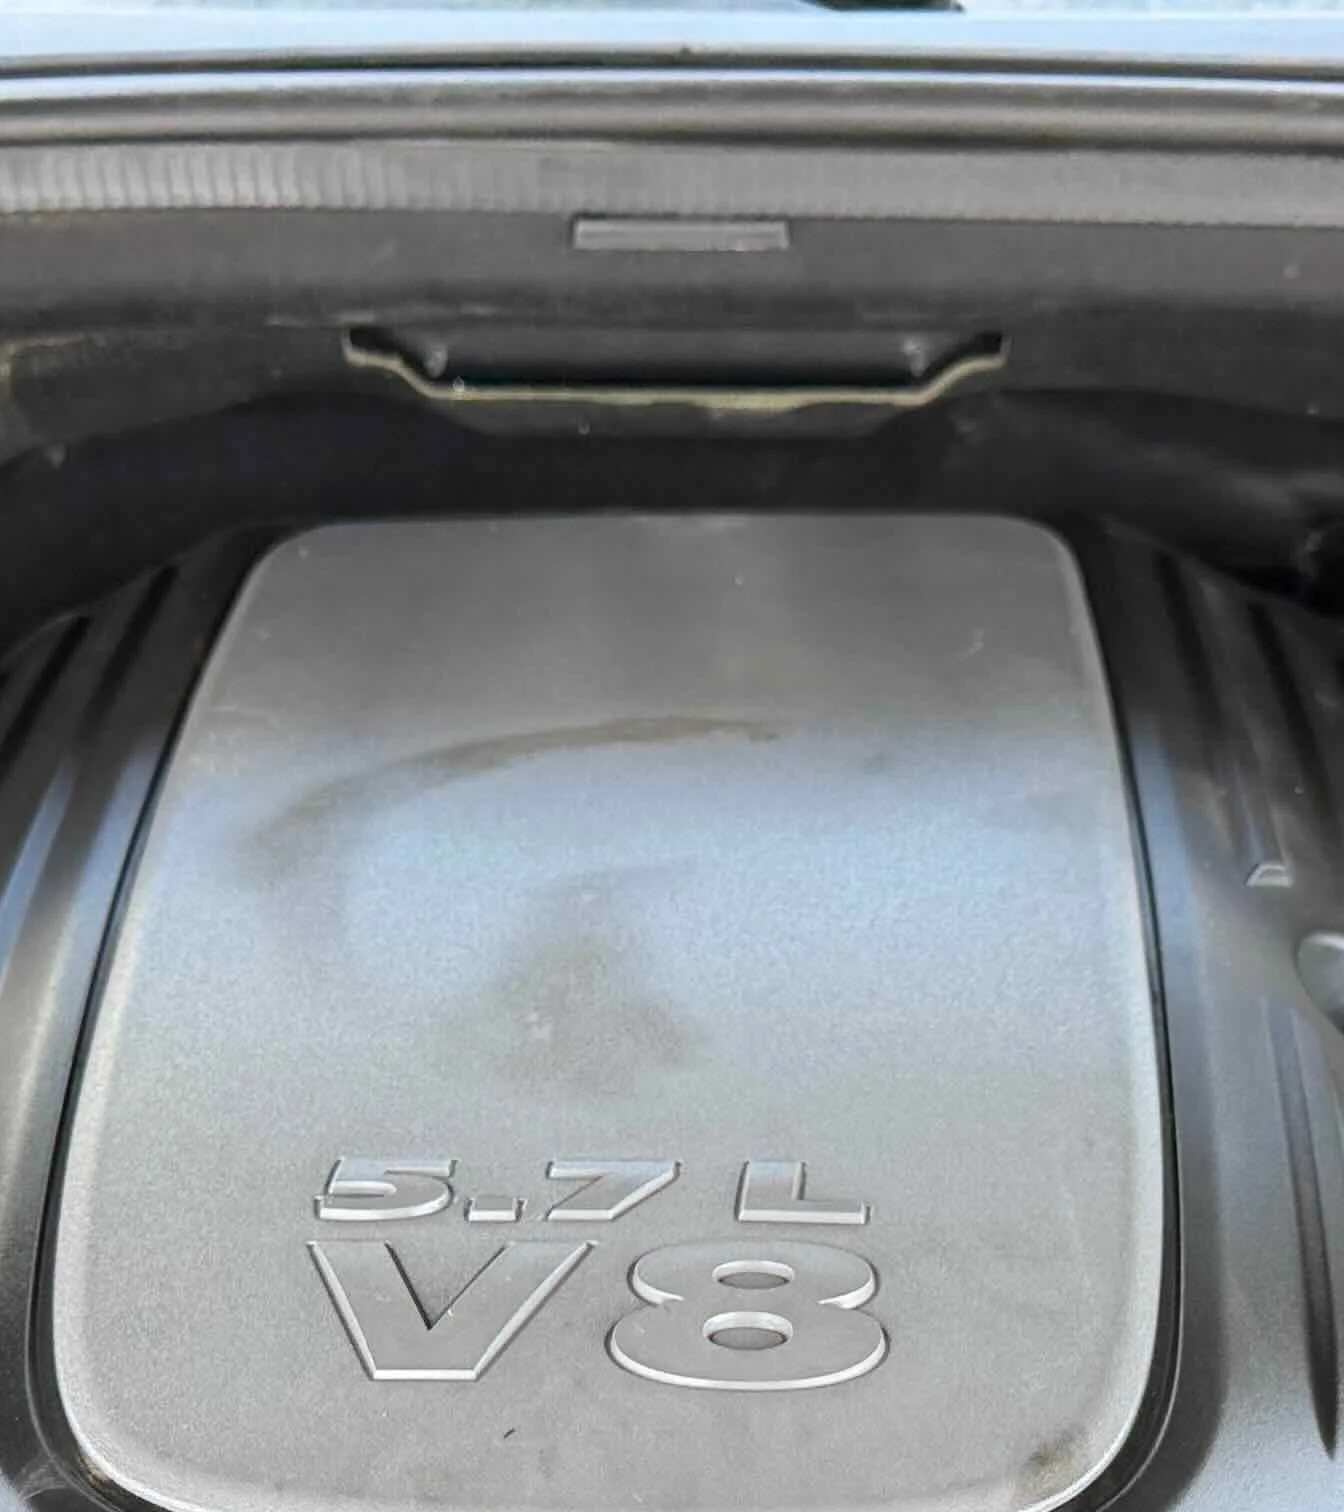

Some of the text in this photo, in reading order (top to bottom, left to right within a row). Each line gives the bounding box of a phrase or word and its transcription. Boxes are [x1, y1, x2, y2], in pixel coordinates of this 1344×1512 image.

[314, 1157, 871, 1225] 5.7 L
[306, 1240, 890, 1392] V8
